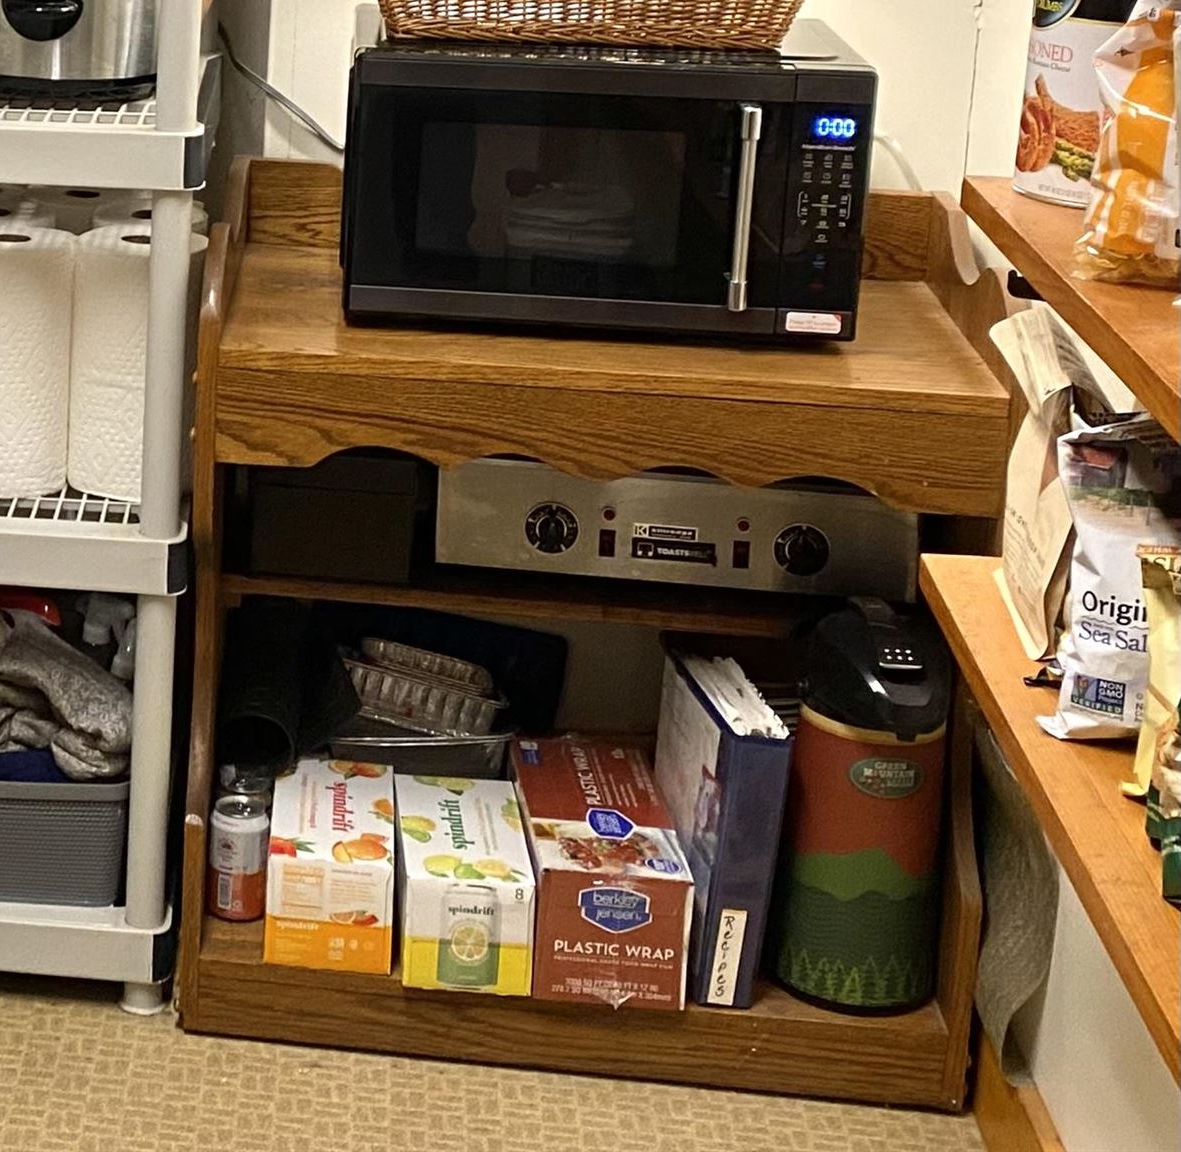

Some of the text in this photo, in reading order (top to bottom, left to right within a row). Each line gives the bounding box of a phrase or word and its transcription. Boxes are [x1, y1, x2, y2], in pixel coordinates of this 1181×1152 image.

[818, 118, 855, 136] 0:00
[1079, 621, 1112, 646] Sea
[1098, 688, 1124, 698] GMO
[1099, 681, 1124, 691] NON
[1072, 696, 1122, 714] VERIFIED
[578, 771, 602, 806] PLASTIC
[325, 782, 356, 833] spindrift
[438, 798, 476, 851] spindrift
[515, 888, 524, 901] 8
[593, 891, 640, 909] berkley
[448, 904, 495, 917] spindrift
[596, 908, 638, 923] jensen
[554, 939, 675, 961] PLASTIC WRAP
